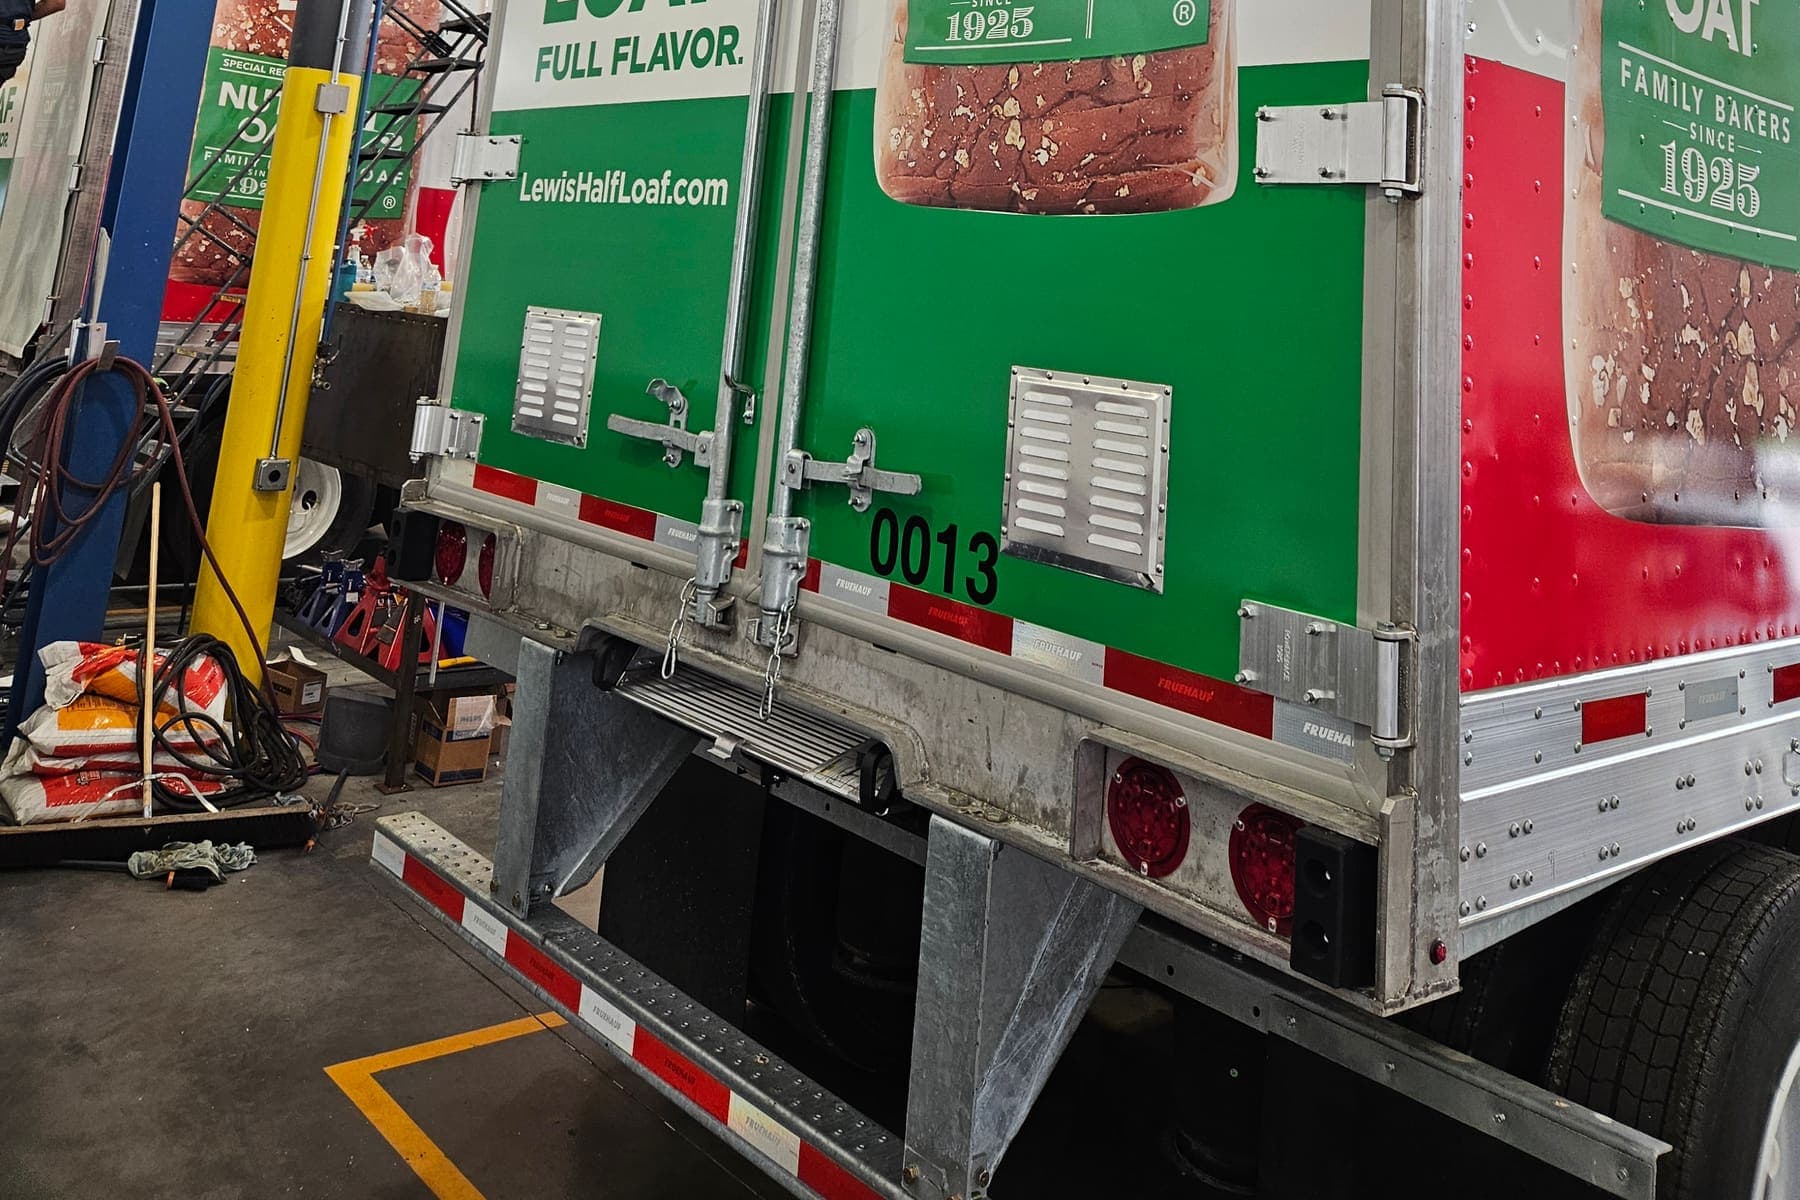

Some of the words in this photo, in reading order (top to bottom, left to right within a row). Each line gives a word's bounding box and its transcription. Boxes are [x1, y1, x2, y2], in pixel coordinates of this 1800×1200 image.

[945, 6, 1035, 41] 1925
[223, 58, 266, 74] SPECIAL
[535, 40, 603, 82] FULL
[611, 24, 743, 76] FLAVOR.
[1621, 57, 1703, 115] FAMILY
[1715, 94, 1790, 144] BAKERS
[1689, 122, 1735, 153] SINCE
[226, 175, 267, 195] 192
[247, 168, 267, 177] SIN
[360, 168, 403, 185] OAF
[1659, 140, 1760, 218] 1925
[519, 169, 729, 206] LewisHalfLoaf.com
[870, 507, 999, 605] 0013
[835, 578, 872, 596] FRUEHAUF
[927, 606, 969, 626] FRUEHAUF
[1033, 638, 1082, 663] FRUEHAUF
[1157, 677, 1214, 703] FRUEHAUF
[1303, 721, 1355, 747] FRUEHA
